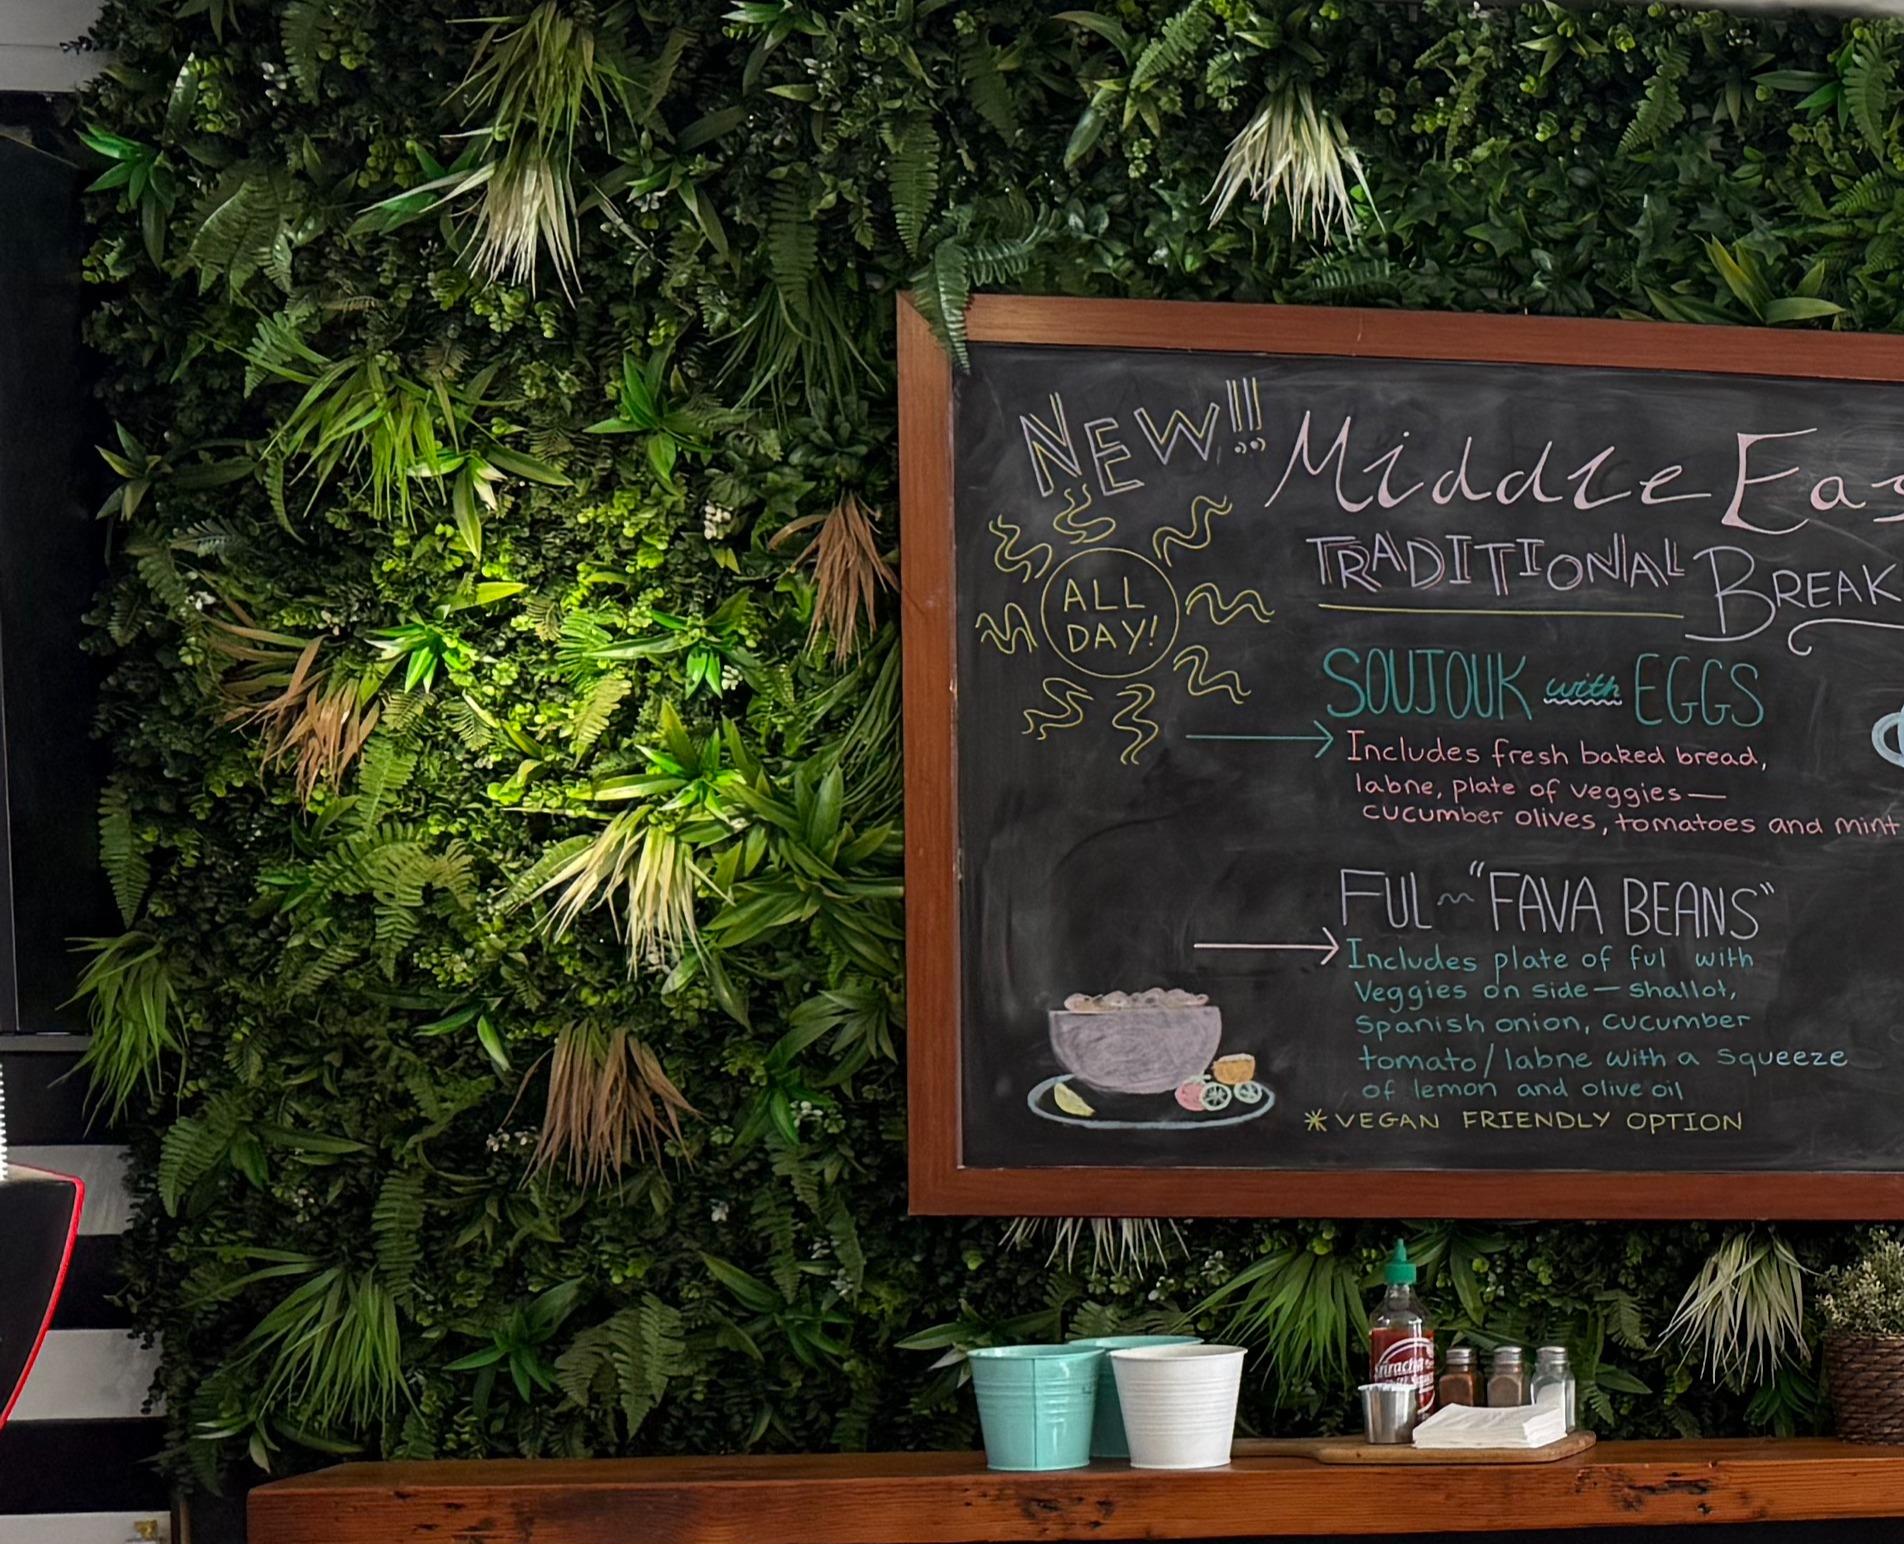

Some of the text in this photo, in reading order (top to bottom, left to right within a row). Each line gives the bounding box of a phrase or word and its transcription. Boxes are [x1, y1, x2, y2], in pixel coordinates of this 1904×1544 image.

[1264, 410, 1711, 512] Middle
[1306, 532, 1686, 596] TRADITIONAL
[1065, 577, 1145, 612] ALL
[1068, 615, 1157, 653] DAY!
[1324, 647, 1764, 728] SOUJOUK with EGGS
[1347, 730, 1766, 772] Includes fresh baked bread,
[1356, 773, 1443, 801] labne,
[1453, 774, 1515, 805] plate
[1530, 778, 1561, 799] of
[1363, 803, 1900, 836] cucumber olives, tomatoes and mint
[1340, 869, 1432, 930] FUL
[1347, 938, 1754, 986] Includes plate of ful with
[1483, 982, 1520, 1000] on
[1532, 979, 1588, 999] side
[1356, 1011, 1752, 1046] Spanish onion, cucumber
[1607, 1045, 1667, 1067] with
[1677, 1050, 1699, 1067] a
[1362, 1078, 1684, 1100] of lemon and olive oil
[1463, 1110, 1611, 1130] FRIENDLY
[1627, 1112, 1743, 1134] OPTION
